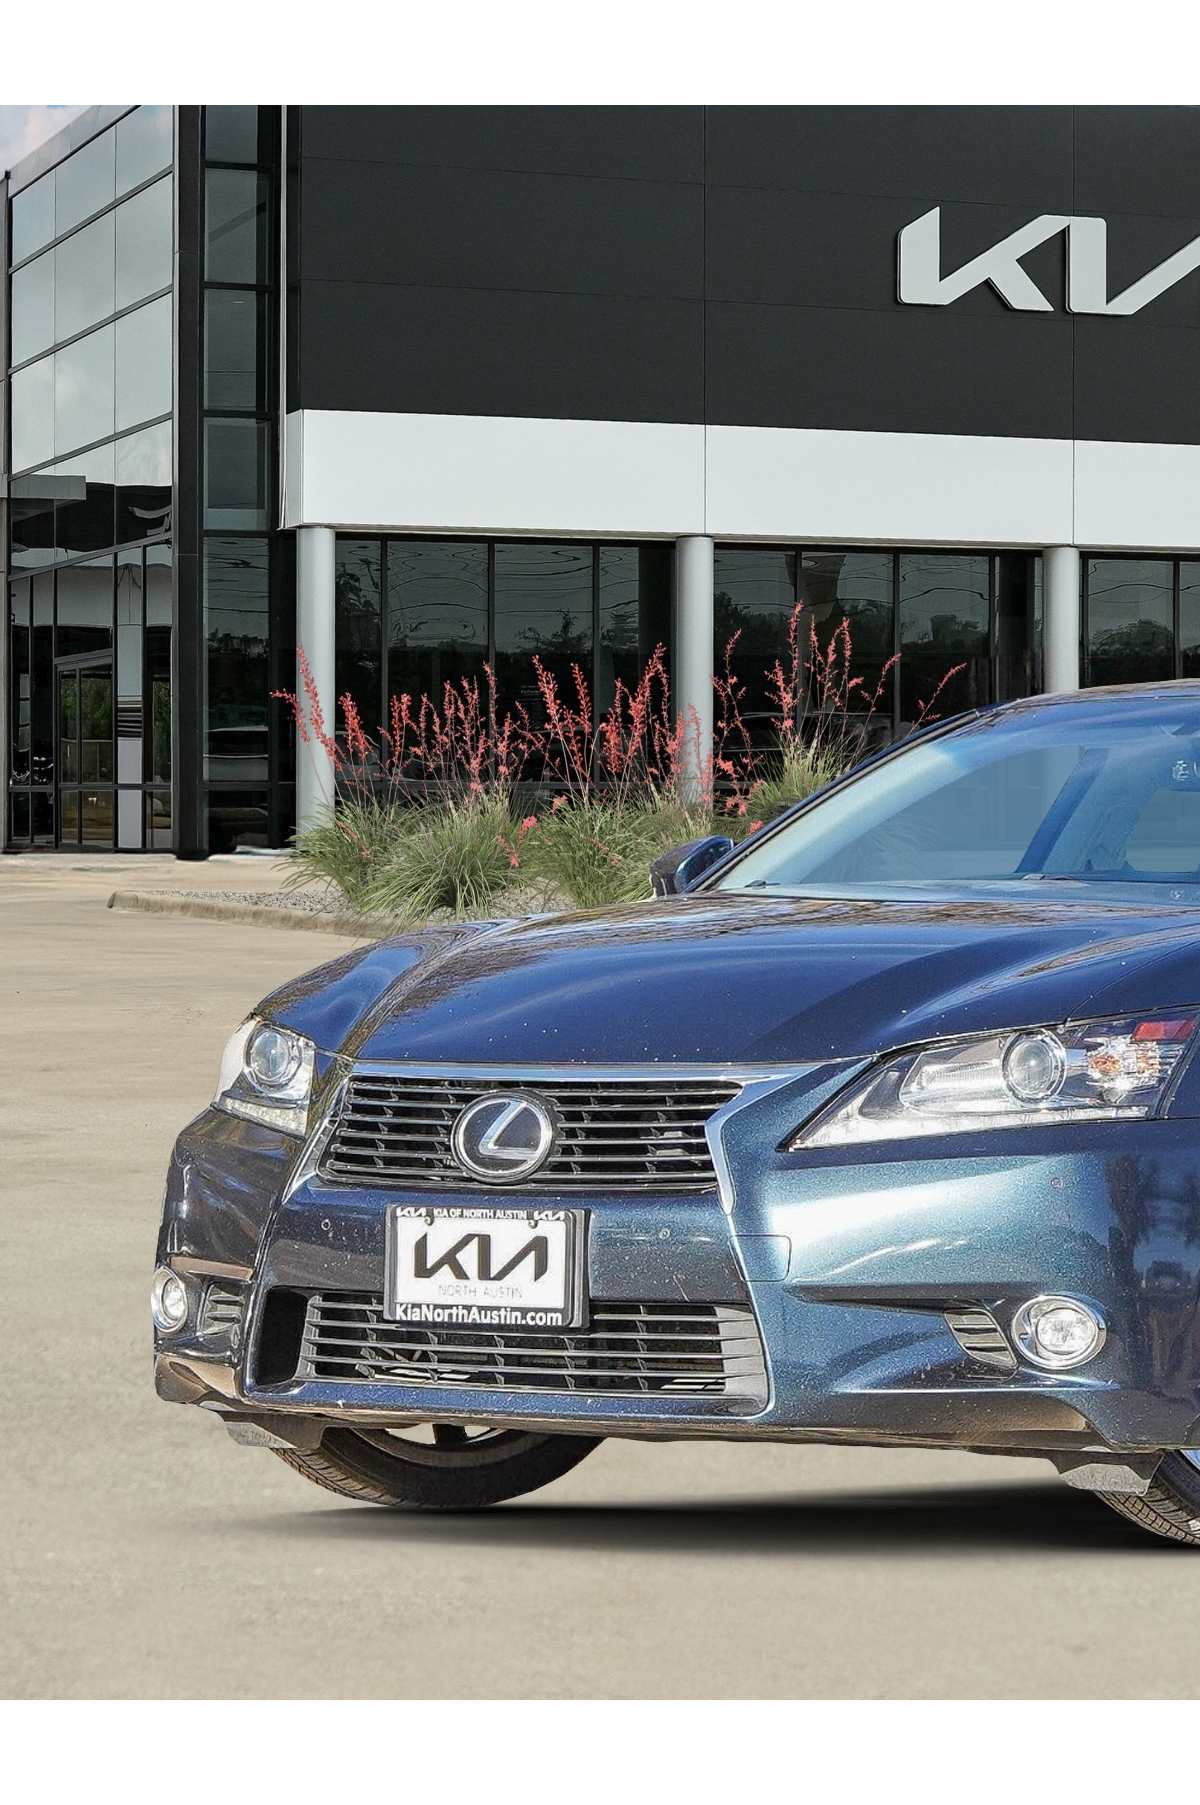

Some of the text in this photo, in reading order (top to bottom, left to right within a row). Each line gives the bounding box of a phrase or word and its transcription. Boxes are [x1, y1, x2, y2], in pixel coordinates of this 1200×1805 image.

[450, 1208, 462, 1218] OF
[463, 1208, 493, 1219] NORTH
[495, 1209, 528, 1220] AUSTIN
[414, 1232, 548, 1282] KIA
[438, 1284, 523, 1300] NORTH AUSTIN
[395, 1304, 563, 1327] KiaNorthAustin.com
